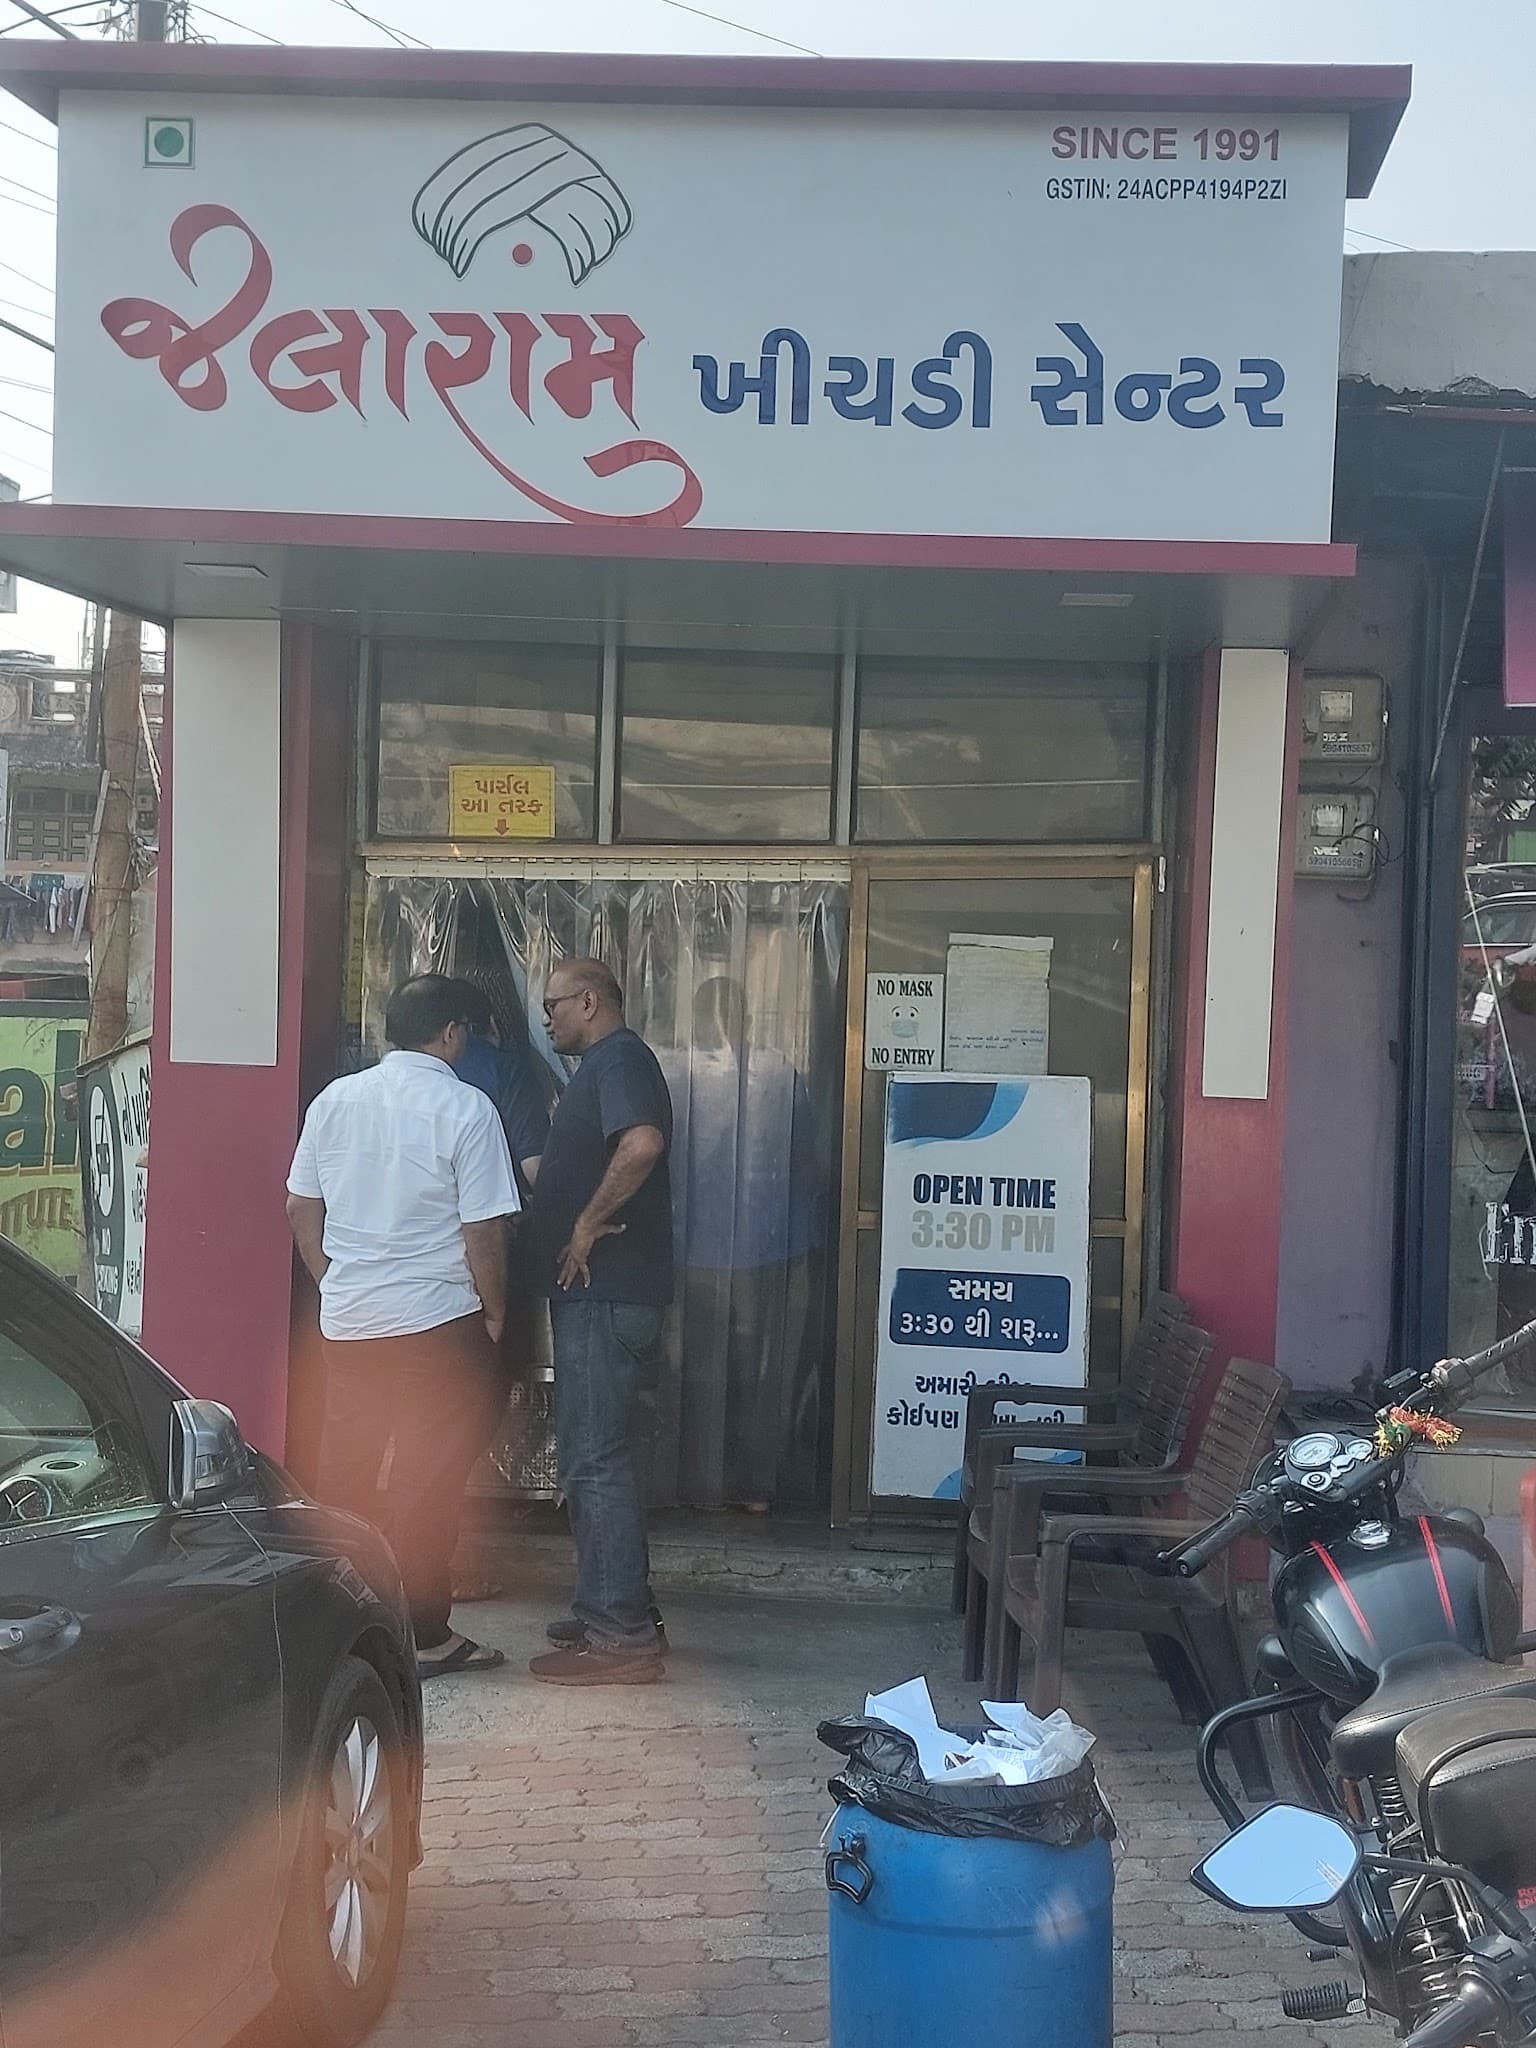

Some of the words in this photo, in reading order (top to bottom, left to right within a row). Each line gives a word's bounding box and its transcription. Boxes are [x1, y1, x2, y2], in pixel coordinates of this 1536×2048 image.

[1051, 126, 1178, 160] SINCE
[1193, 127, 1281, 161] 1991
[1046, 177, 1111, 199] GSTIN:
[100, 203, 703, 527] જલારામ
[692, 327, 994, 429] ખીચડી
[1029, 322, 1287, 429] સેન્ટર
[460, 798, 489, 813] આ
[498, 799, 544, 816] તરફ
[876, 979, 895, 997] NO
[898, 980, 933, 997] MASK
[871, 1047, 890, 1064] NO
[893, 1048, 936, 1066] ENTRY
[913, 1173, 984, 1206] OPEN
[989, 1177, 1057, 1209] TIME
[911, 1209, 992, 1250] 3:30
[1001, 1214, 1056, 1253] PM
[947, 1278, 1015, 1303] સમય
[963, 1307, 991, 1338] થી
[915, 1370, 977, 1396] અમારી
[886, 1399, 960, 1430] કોઈપણ
